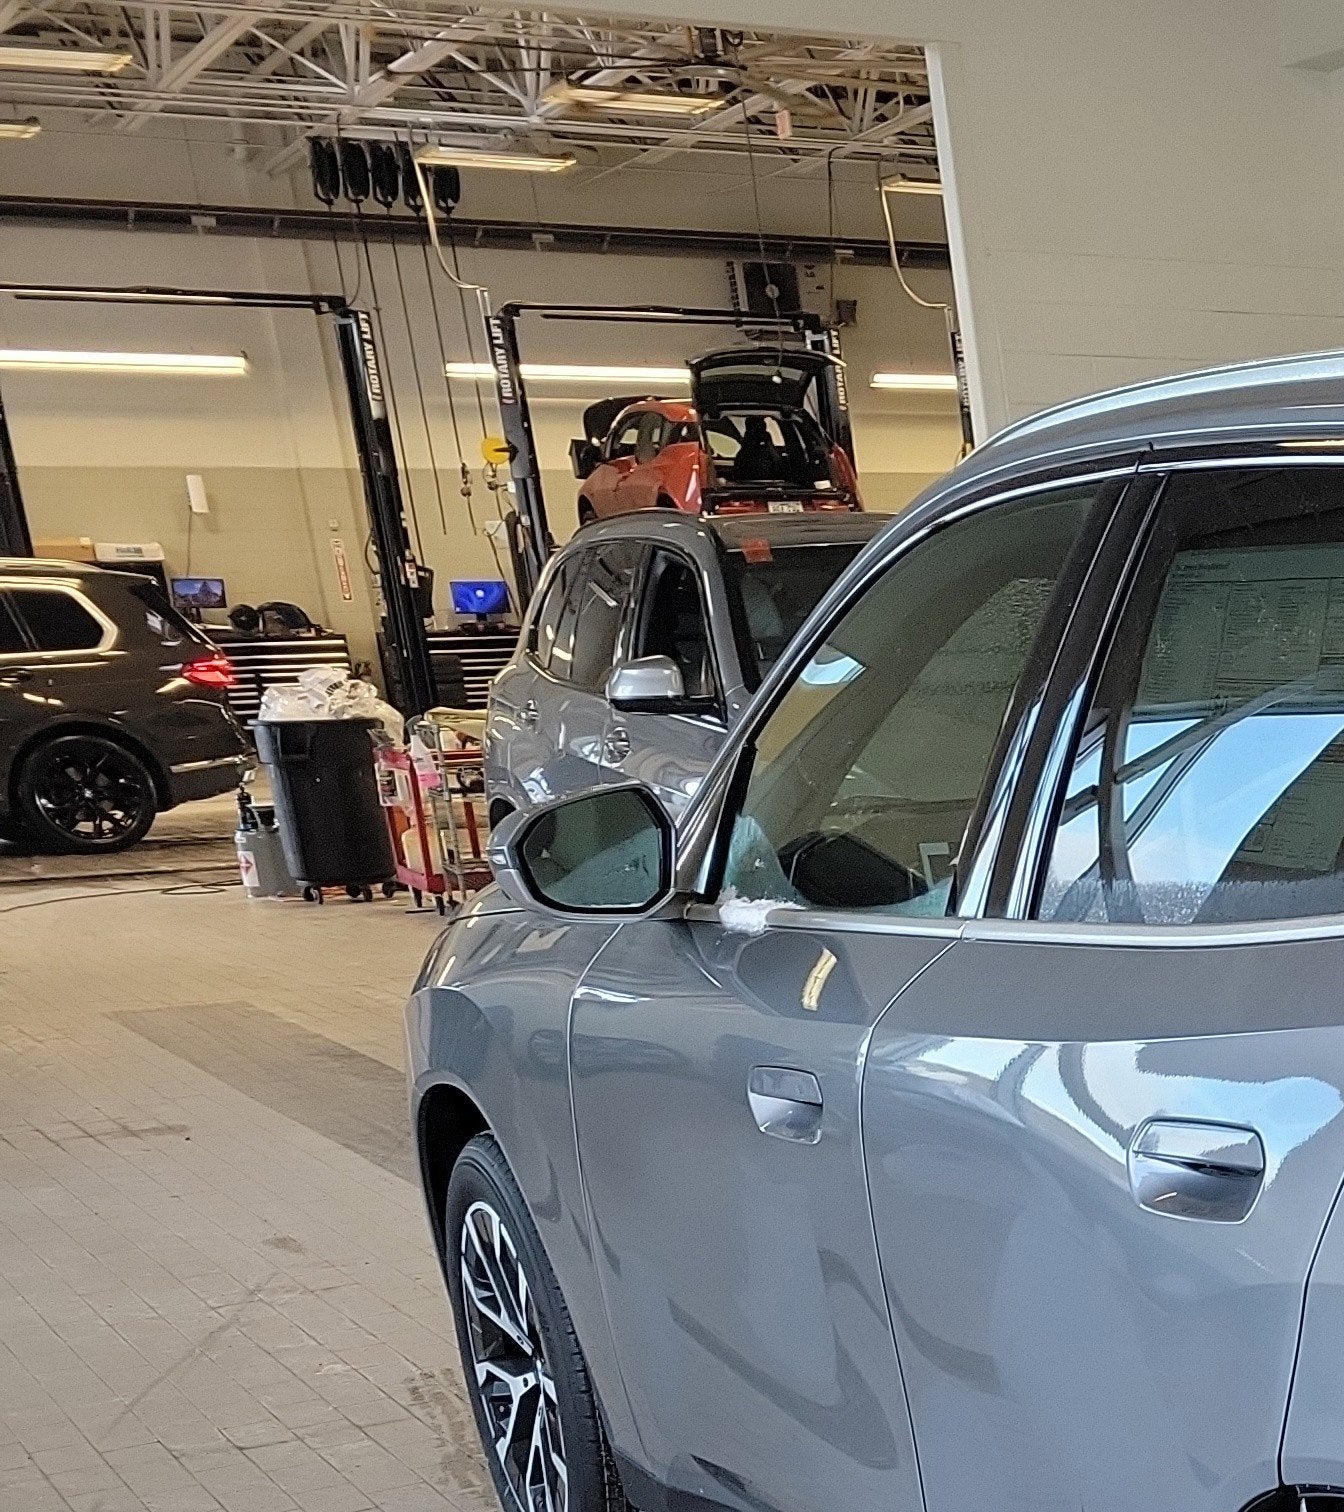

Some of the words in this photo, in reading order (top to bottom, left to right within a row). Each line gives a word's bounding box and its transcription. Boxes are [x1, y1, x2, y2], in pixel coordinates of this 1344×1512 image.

[358, 312, 372, 339] LIFT
[491, 319, 504, 344] LIFT
[363, 342, 381, 393] ROTARY
[496, 348, 512, 397] ROTARY
[834, 364, 847, 404] ROTAR
